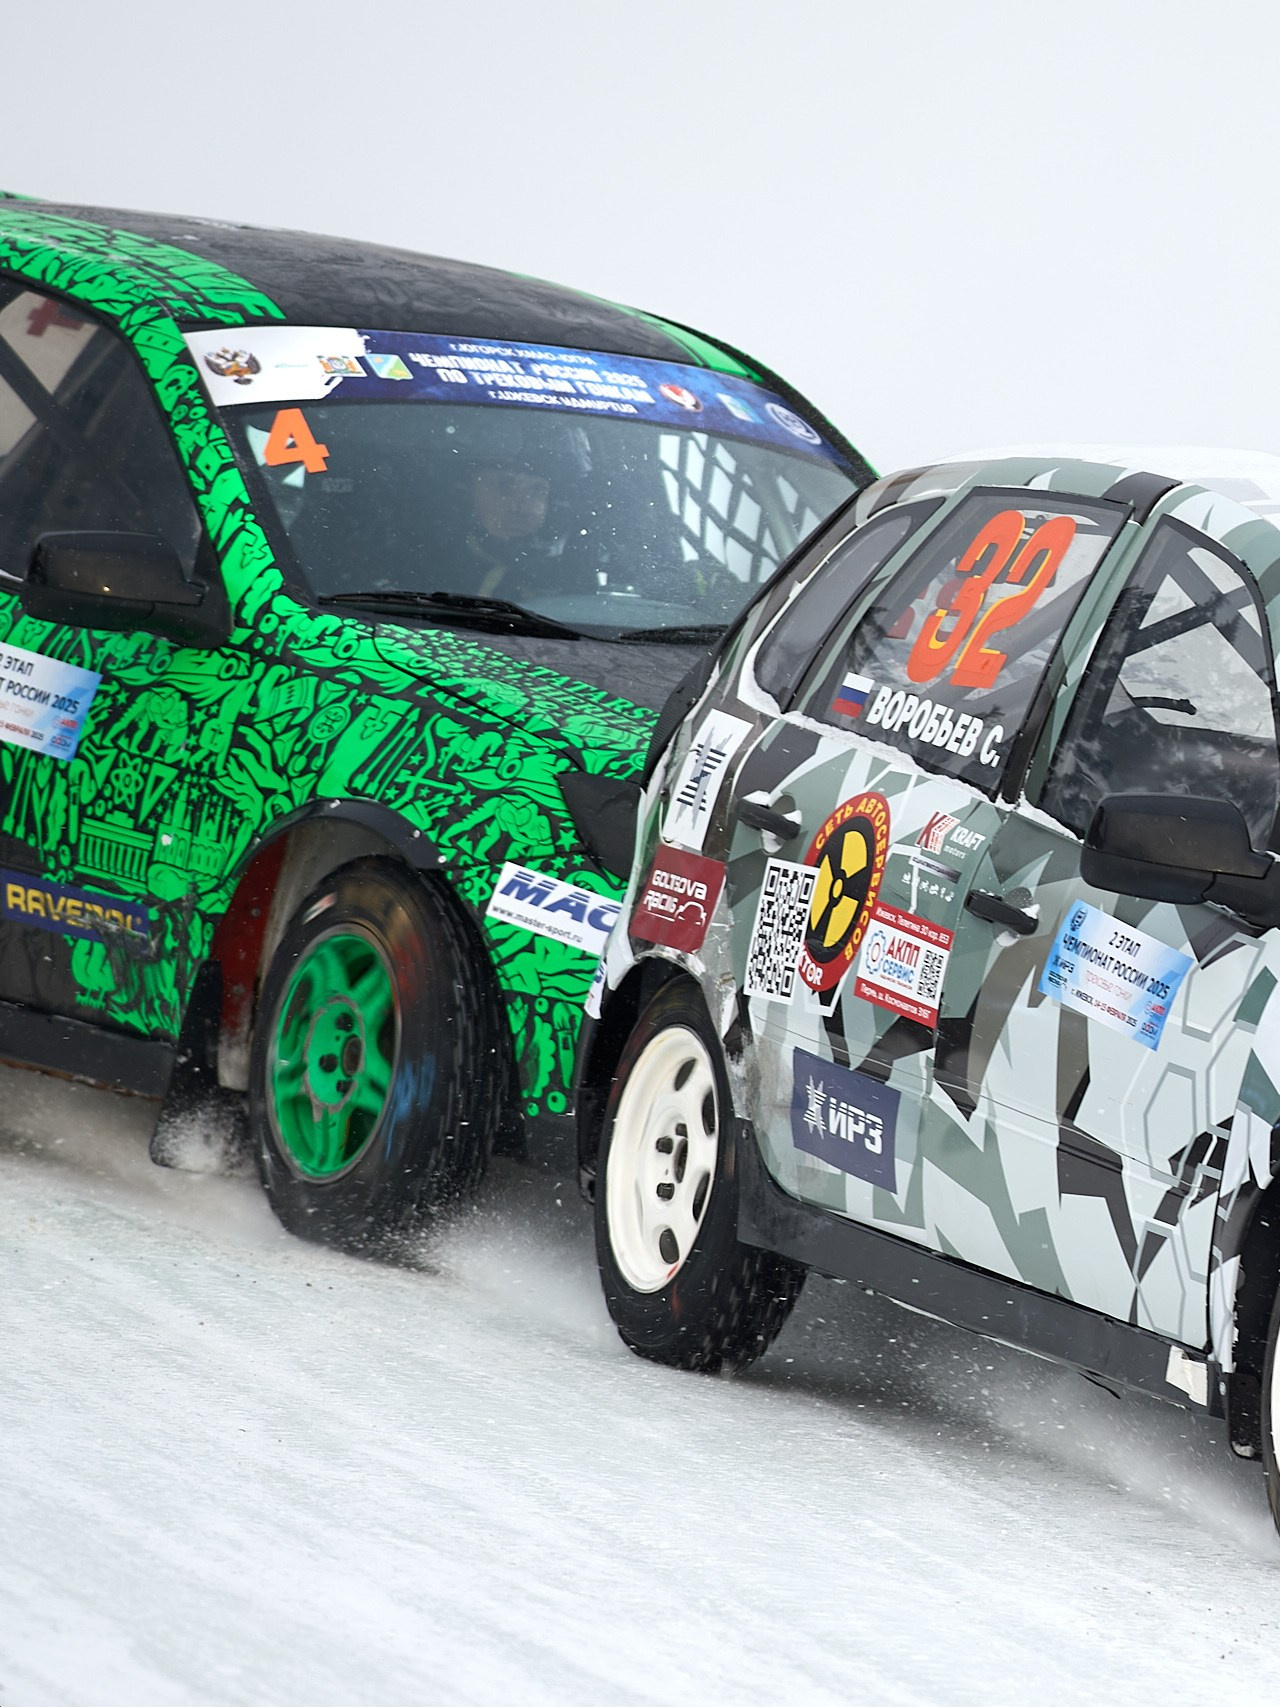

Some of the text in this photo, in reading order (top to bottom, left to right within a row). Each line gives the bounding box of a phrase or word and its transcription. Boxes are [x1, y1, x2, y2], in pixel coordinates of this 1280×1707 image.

[409, 352, 648, 389] ЧЕМПИОНАТ РОССИИ 2025
[436, 368, 656, 404] ПО ТРЕКОВЫМ ГОНКАМ
[263, 407, 330, 473] 4
[906, 509, 1077, 689] 32
[4, 656, 35, 677] ЭТАП
[6, 680, 51, 706] РОССИИ
[52, 694, 80, 715] 2025
[866, 686, 1005, 768] ВОРОБЬЕВ С.
[949, 825, 986, 851] KRAFT
[815, 797, 887, 961] СЕТЬ АВТОСЕРВИСОВ
[492, 905, 583, 944] www.master-sport.ru
[886, 936, 921, 968] АКПП
[1108, 931, 1142, 957] 2 ЭТАП
[882, 959, 915, 984] СЕРВИС
[1062, 933, 1172, 1000] ЧЕМПИОНАТ РОССИИ 2025
[828, 1096, 883, 1155] ИРЗ
